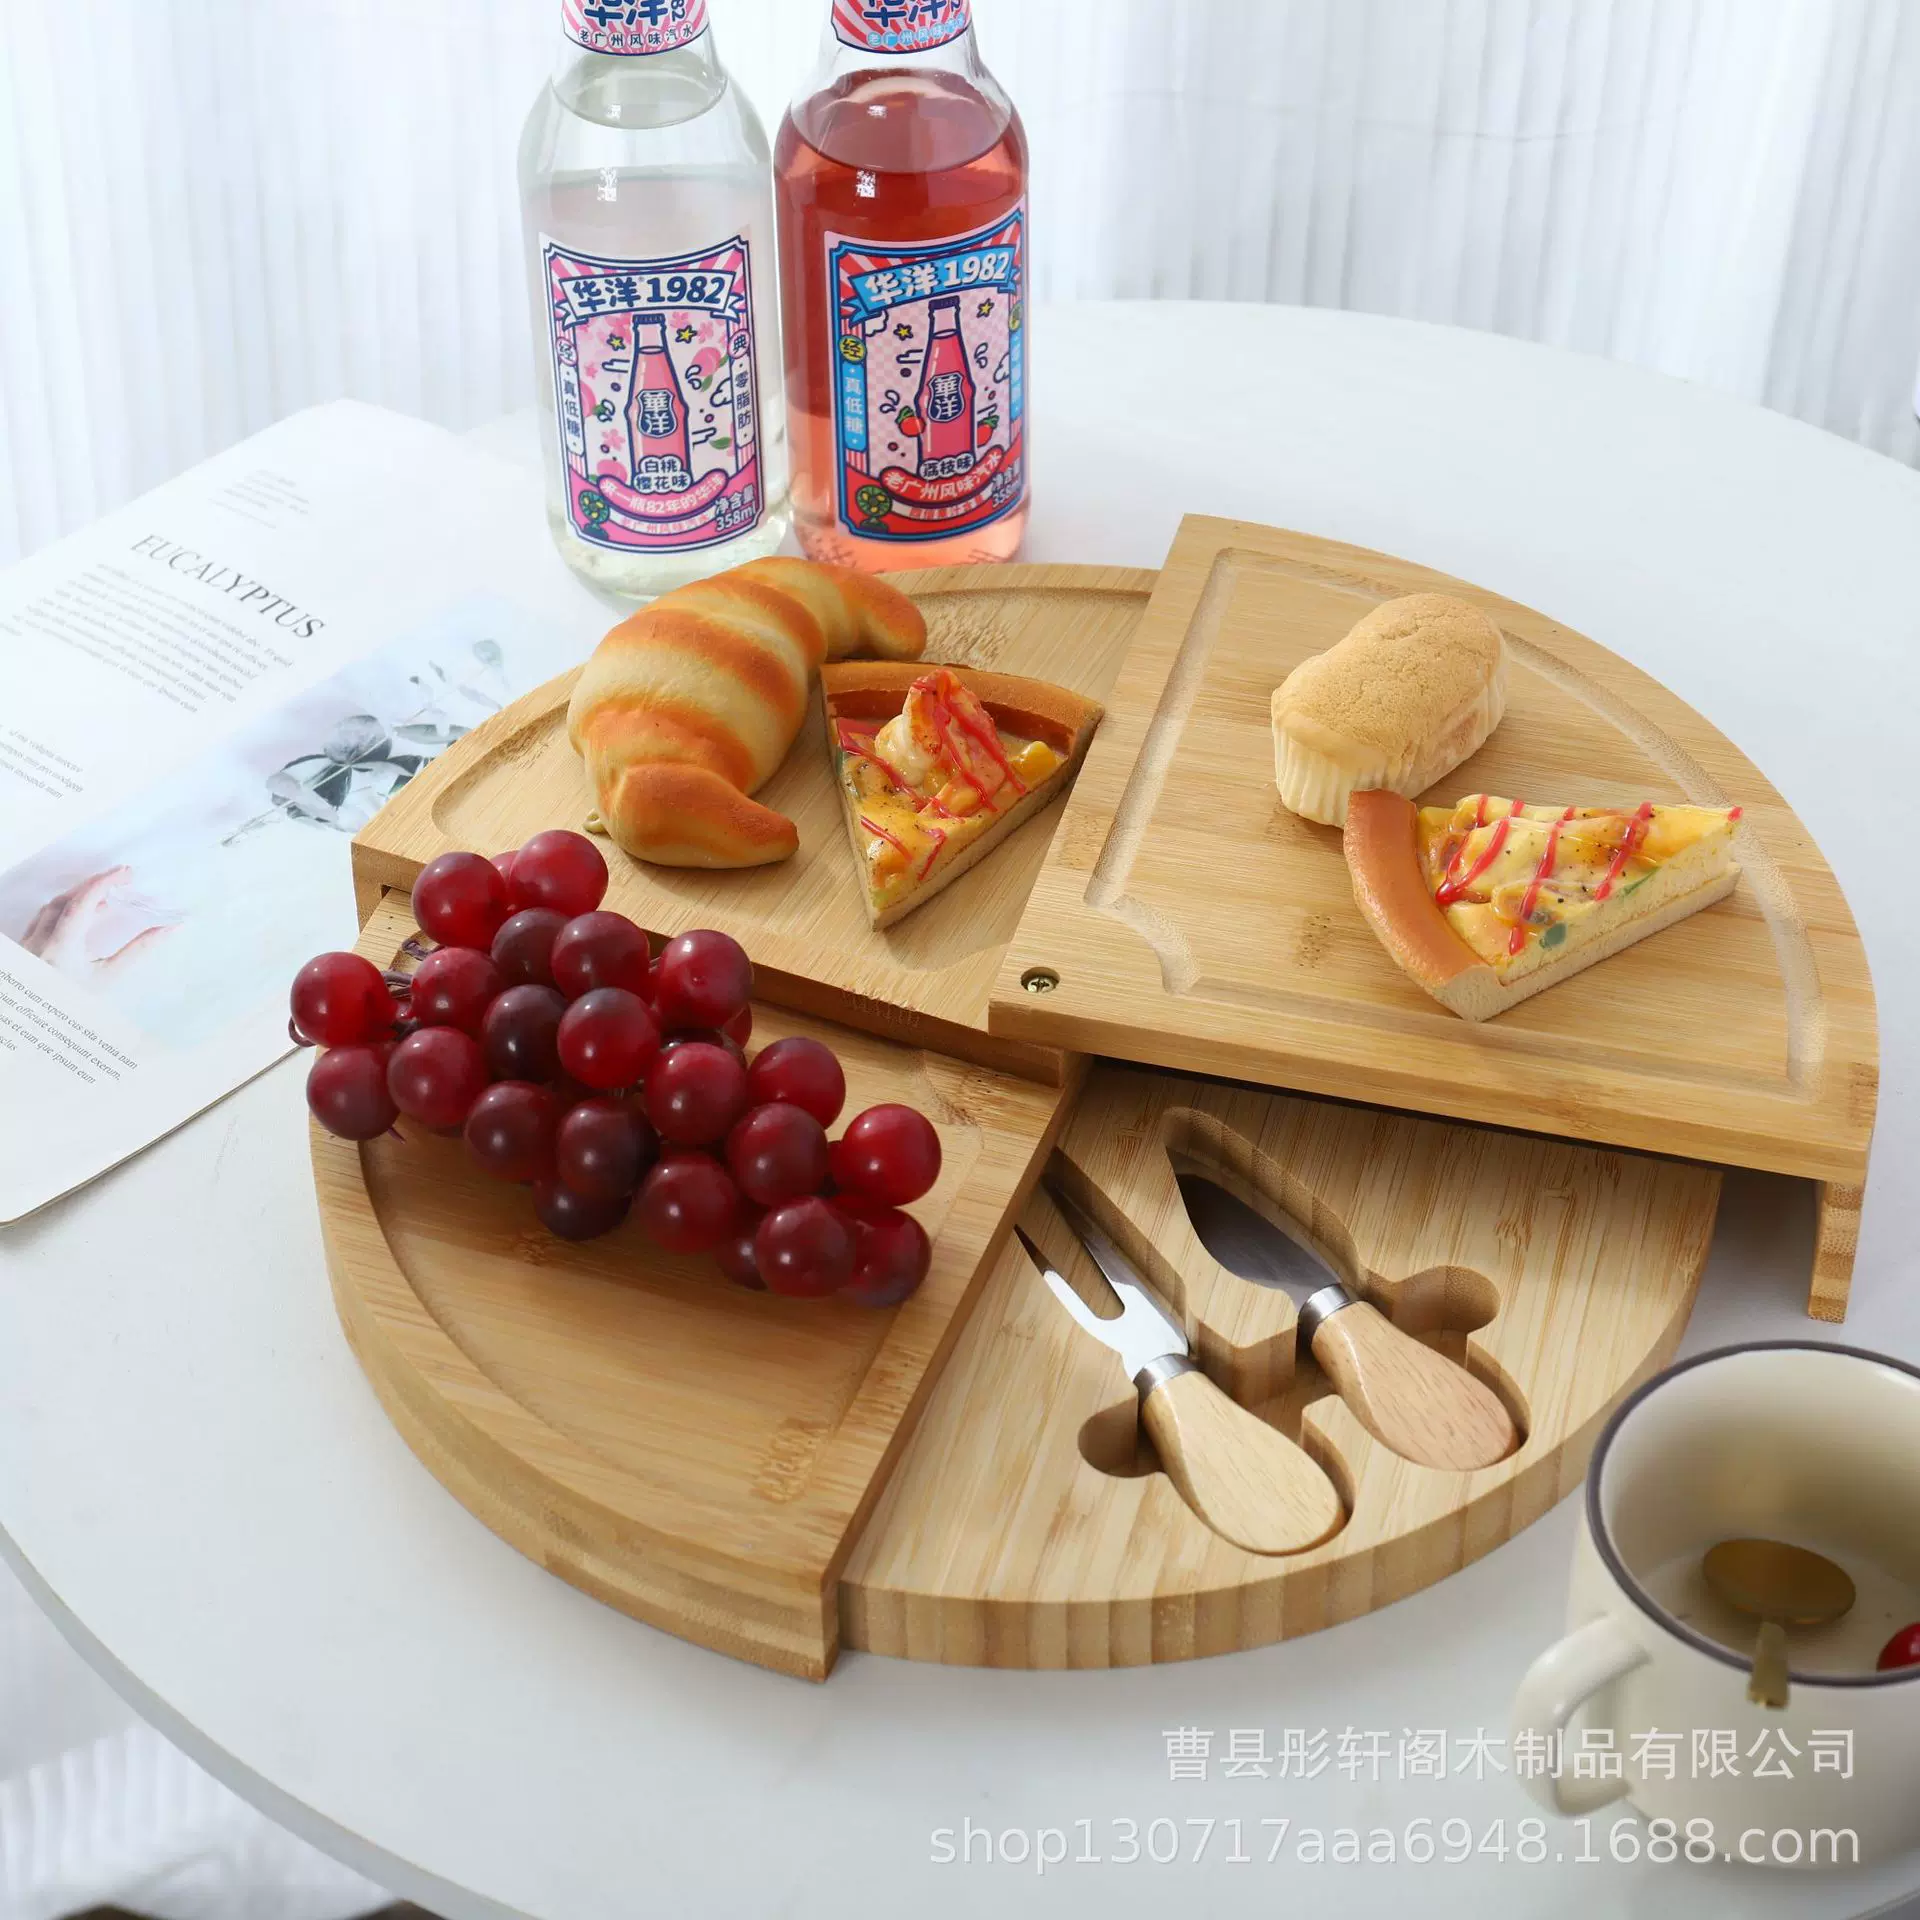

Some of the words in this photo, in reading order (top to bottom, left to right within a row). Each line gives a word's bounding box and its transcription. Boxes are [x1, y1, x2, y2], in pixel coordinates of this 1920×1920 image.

[580, 24, 693, 46] 老广州风味汽水
[573, 276, 725, 311] 华洋1982
[865, 252, 1009, 305] 华洋1982
[644, 459, 679, 473] 白桃
[884, 451, 999, 499] 老广州风味汽水
[131, 534, 326, 639] EUCALYPTUS
